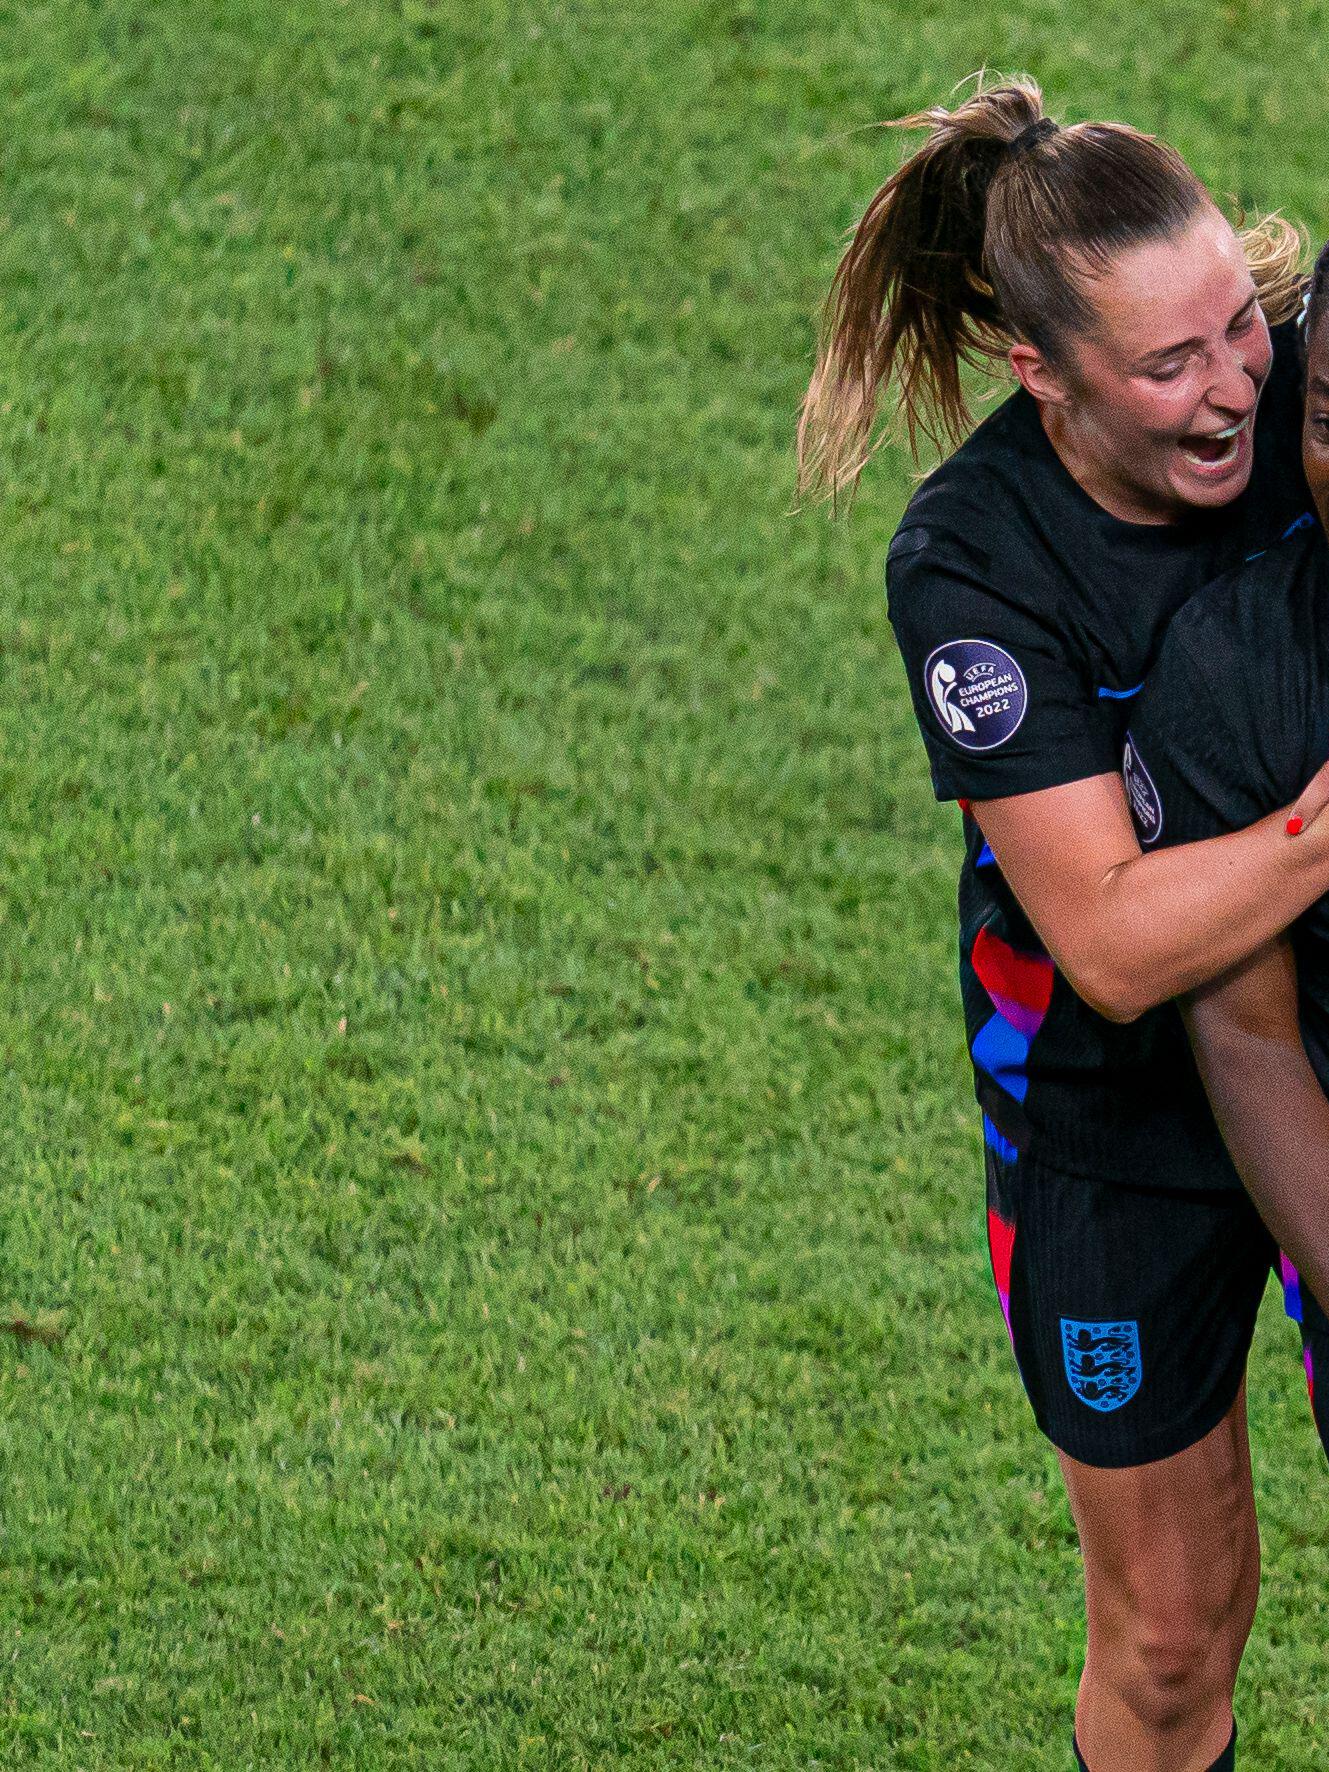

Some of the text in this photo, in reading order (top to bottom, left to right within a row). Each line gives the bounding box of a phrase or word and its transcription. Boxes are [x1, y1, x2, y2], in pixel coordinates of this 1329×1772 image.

[966, 665, 995, 680] UEFA
[958, 673, 1013, 697] EUROPEAN
[960, 682, 1019, 707] CHAMPIONS
[975, 699, 1011, 718] 2022
